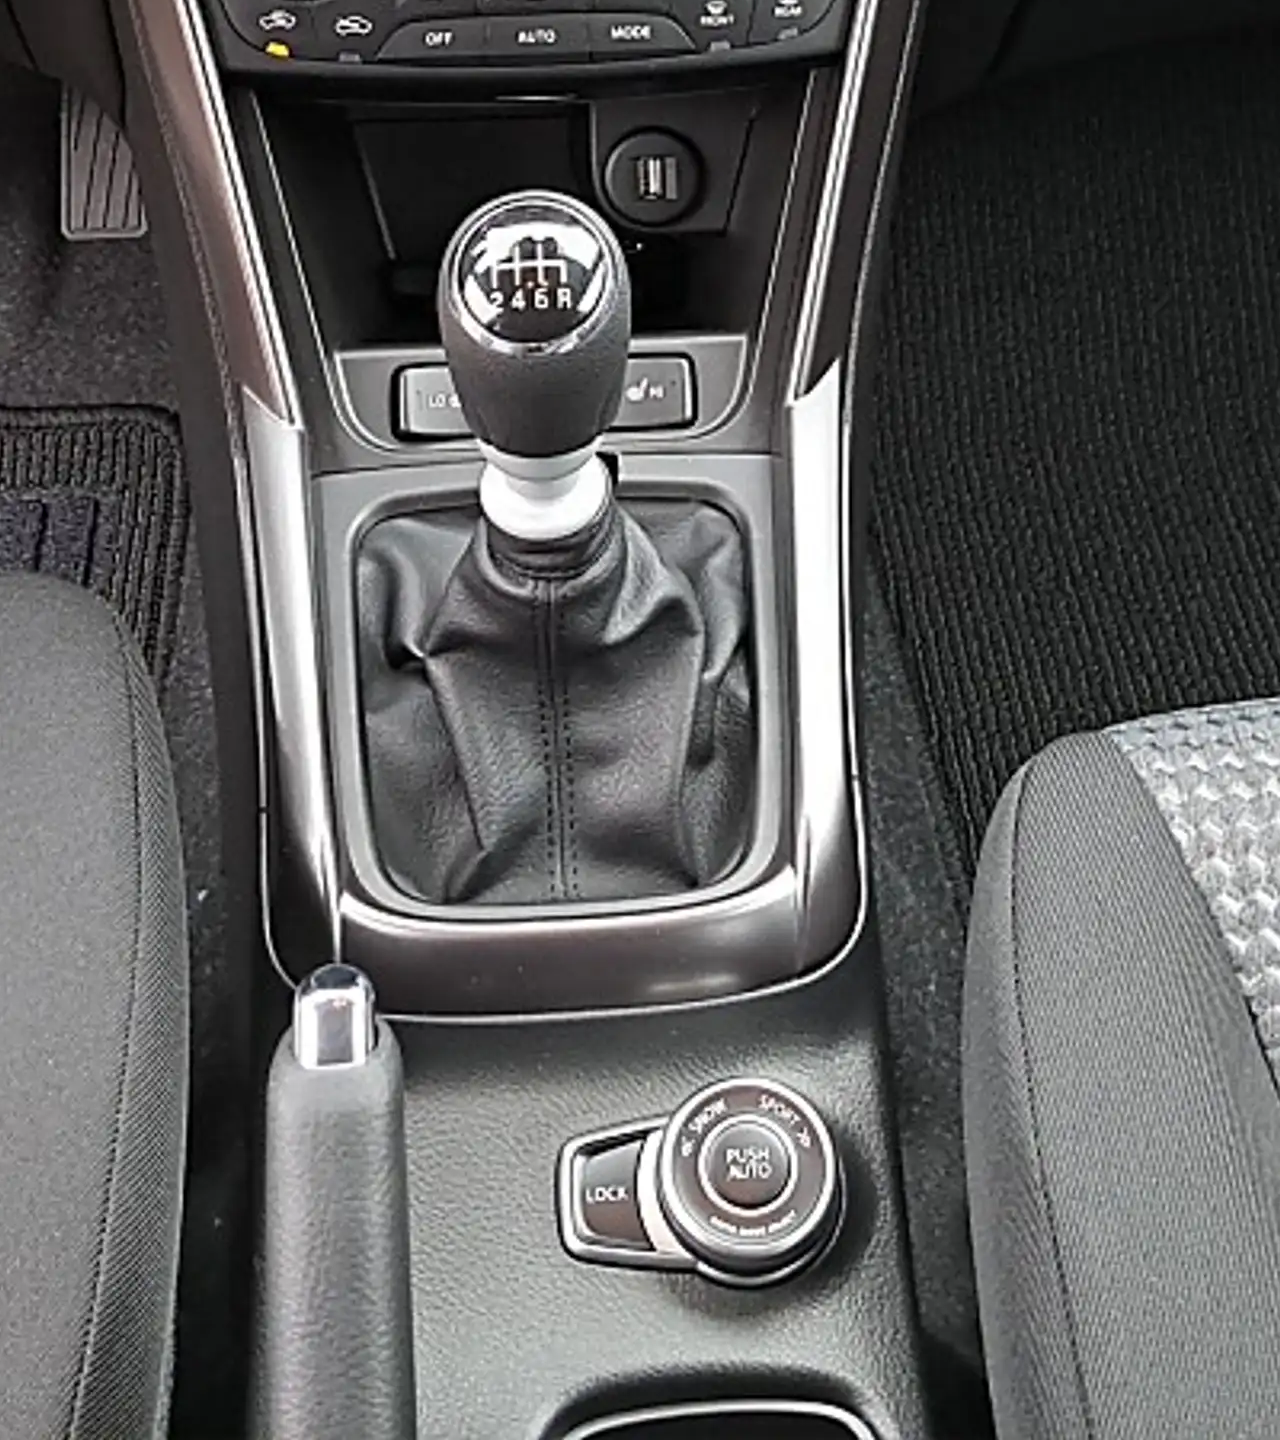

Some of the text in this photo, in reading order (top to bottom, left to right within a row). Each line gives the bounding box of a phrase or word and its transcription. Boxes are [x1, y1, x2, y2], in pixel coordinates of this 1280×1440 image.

[424, 32, 454, 47] OFF
[518, 28, 557, 44] AUTO
[610, 26, 651, 40] MODE
[511, 287, 526, 309] 4
[534, 287, 549, 309] 6
[556, 287, 572, 309] R
[725, 1146, 770, 1163] PUSH
[726, 1161, 772, 1181] AUTO
[585, 1188, 628, 1204] LOCK
